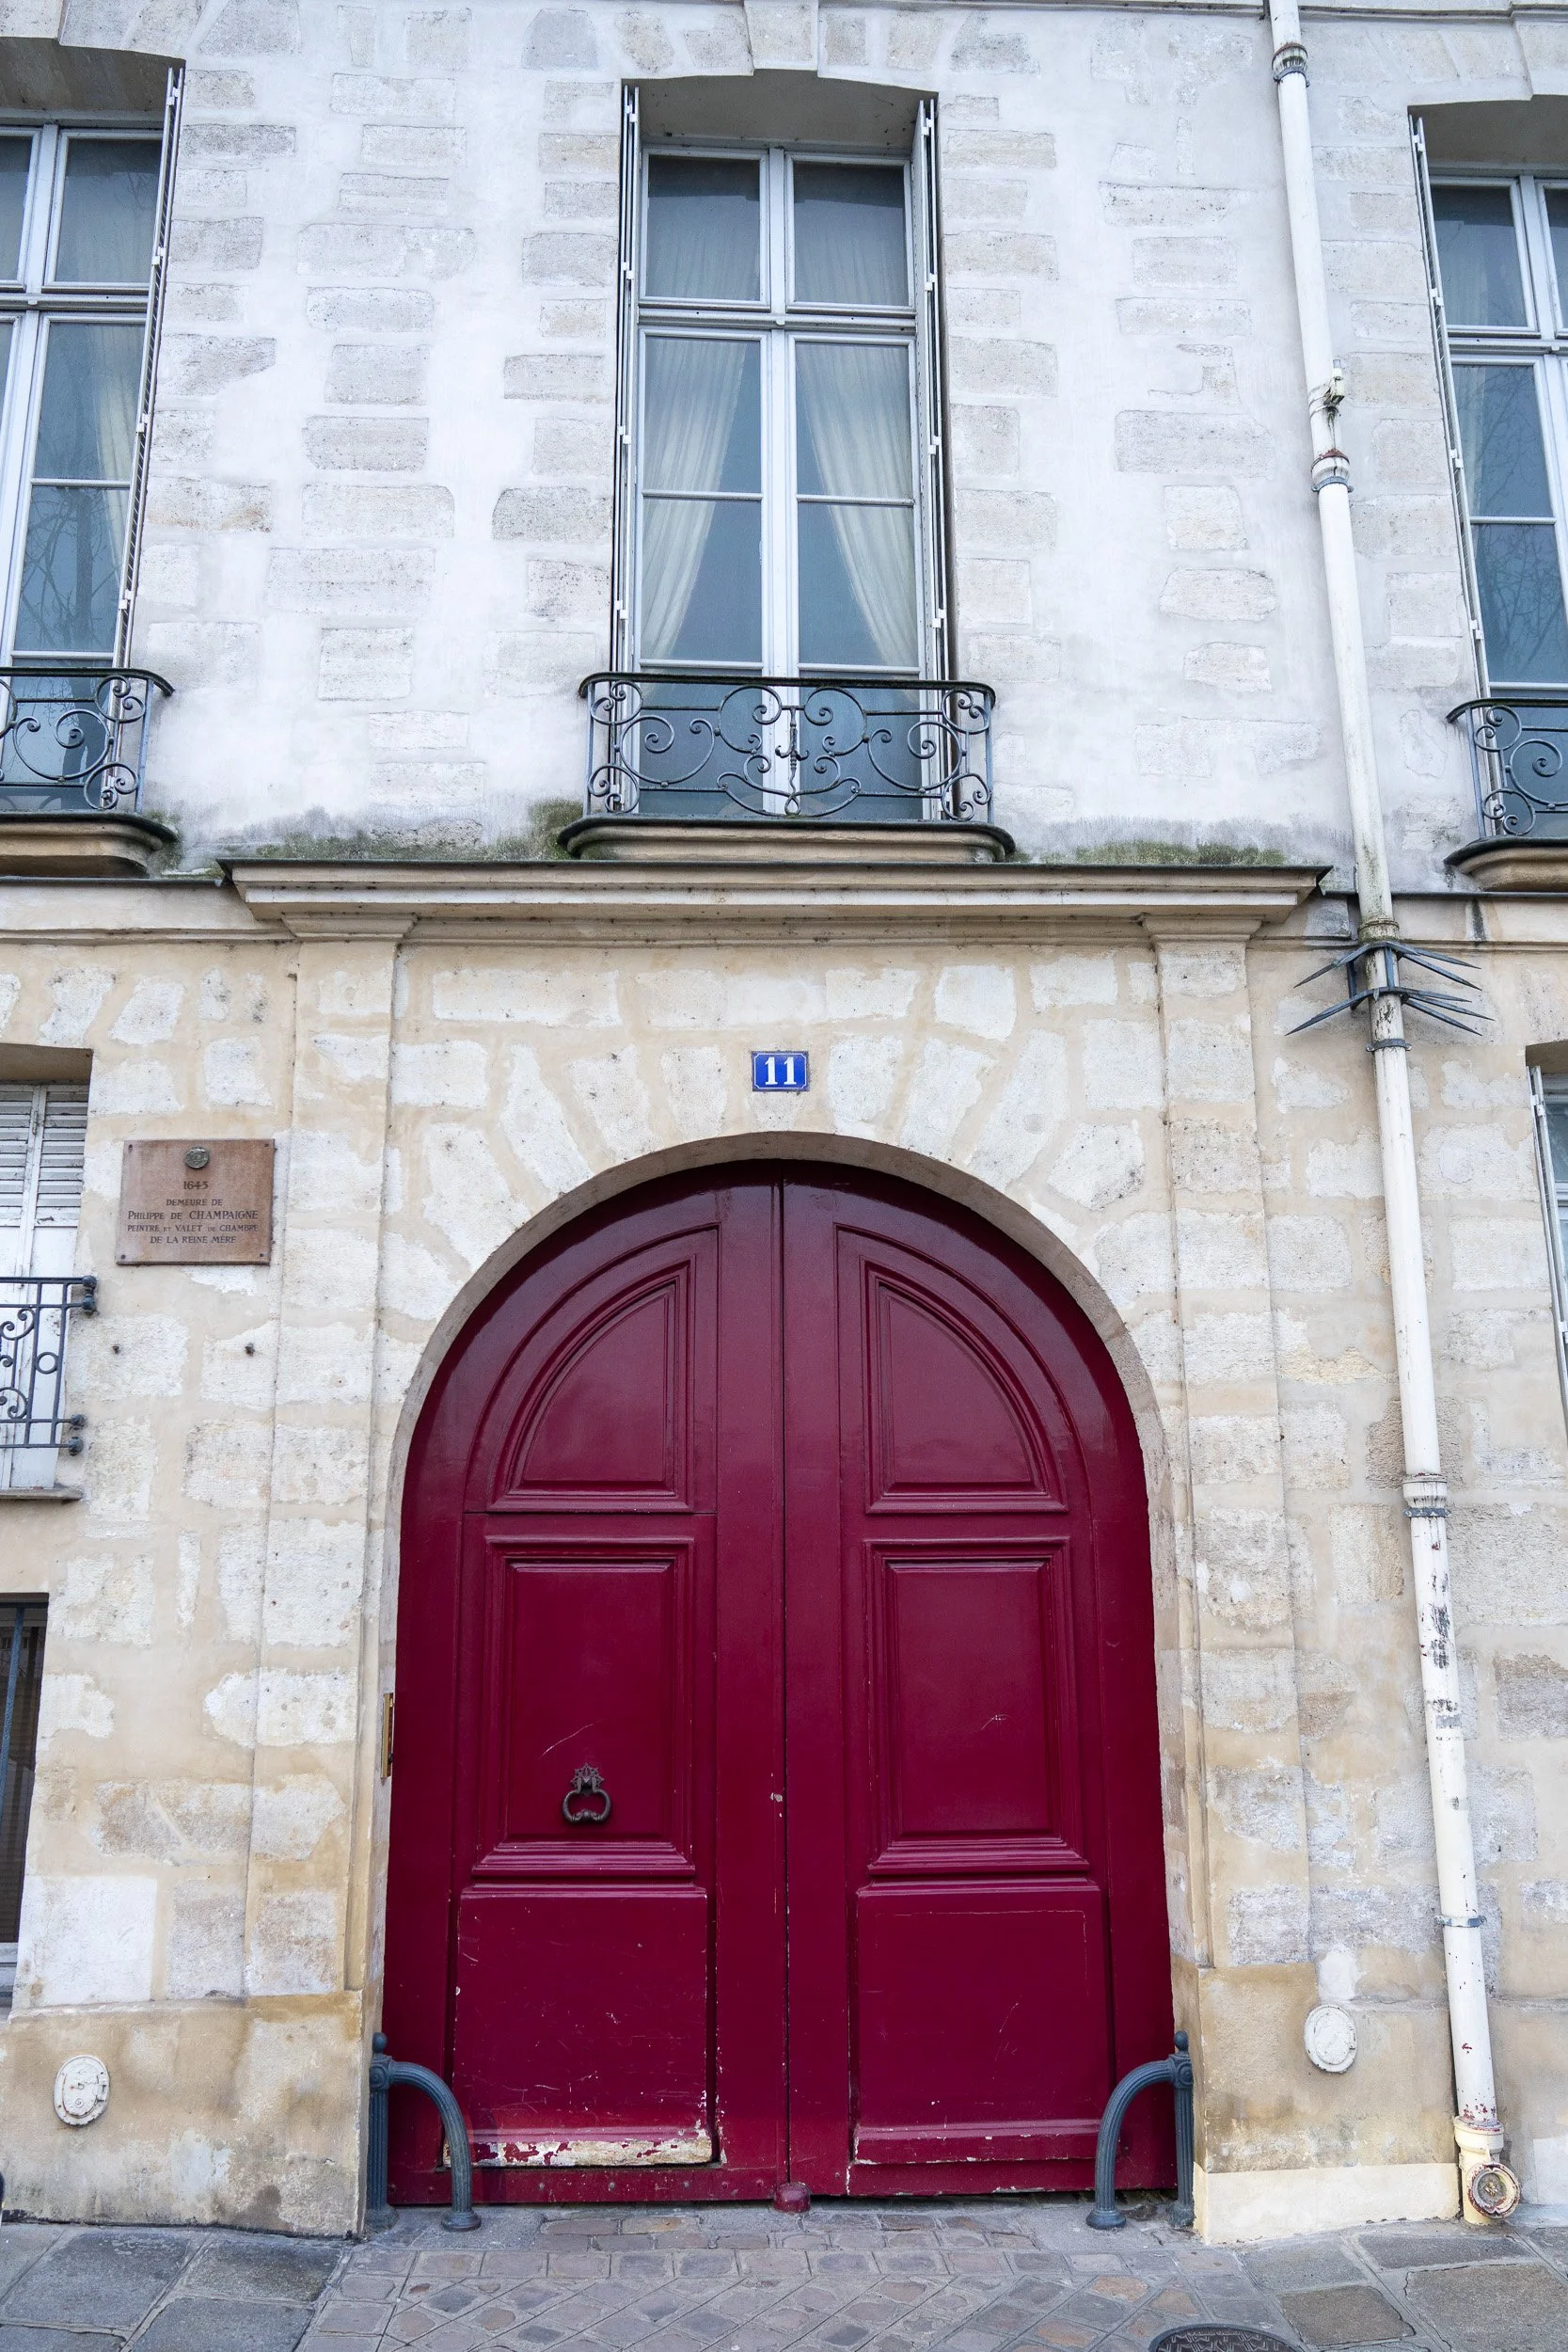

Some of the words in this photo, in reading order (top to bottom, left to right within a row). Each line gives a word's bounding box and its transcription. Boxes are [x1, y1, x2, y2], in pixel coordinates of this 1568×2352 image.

[765, 1057, 797, 1085] 11
[170, 1212, 182, 1220] DE
[189, 1210, 259, 1220] CHAMPAIGNE
[127, 1224, 160, 1232] PEINTRE
[175, 1224, 202, 1232] VALET
[219, 1224, 259, 1232] CHAMBRE
